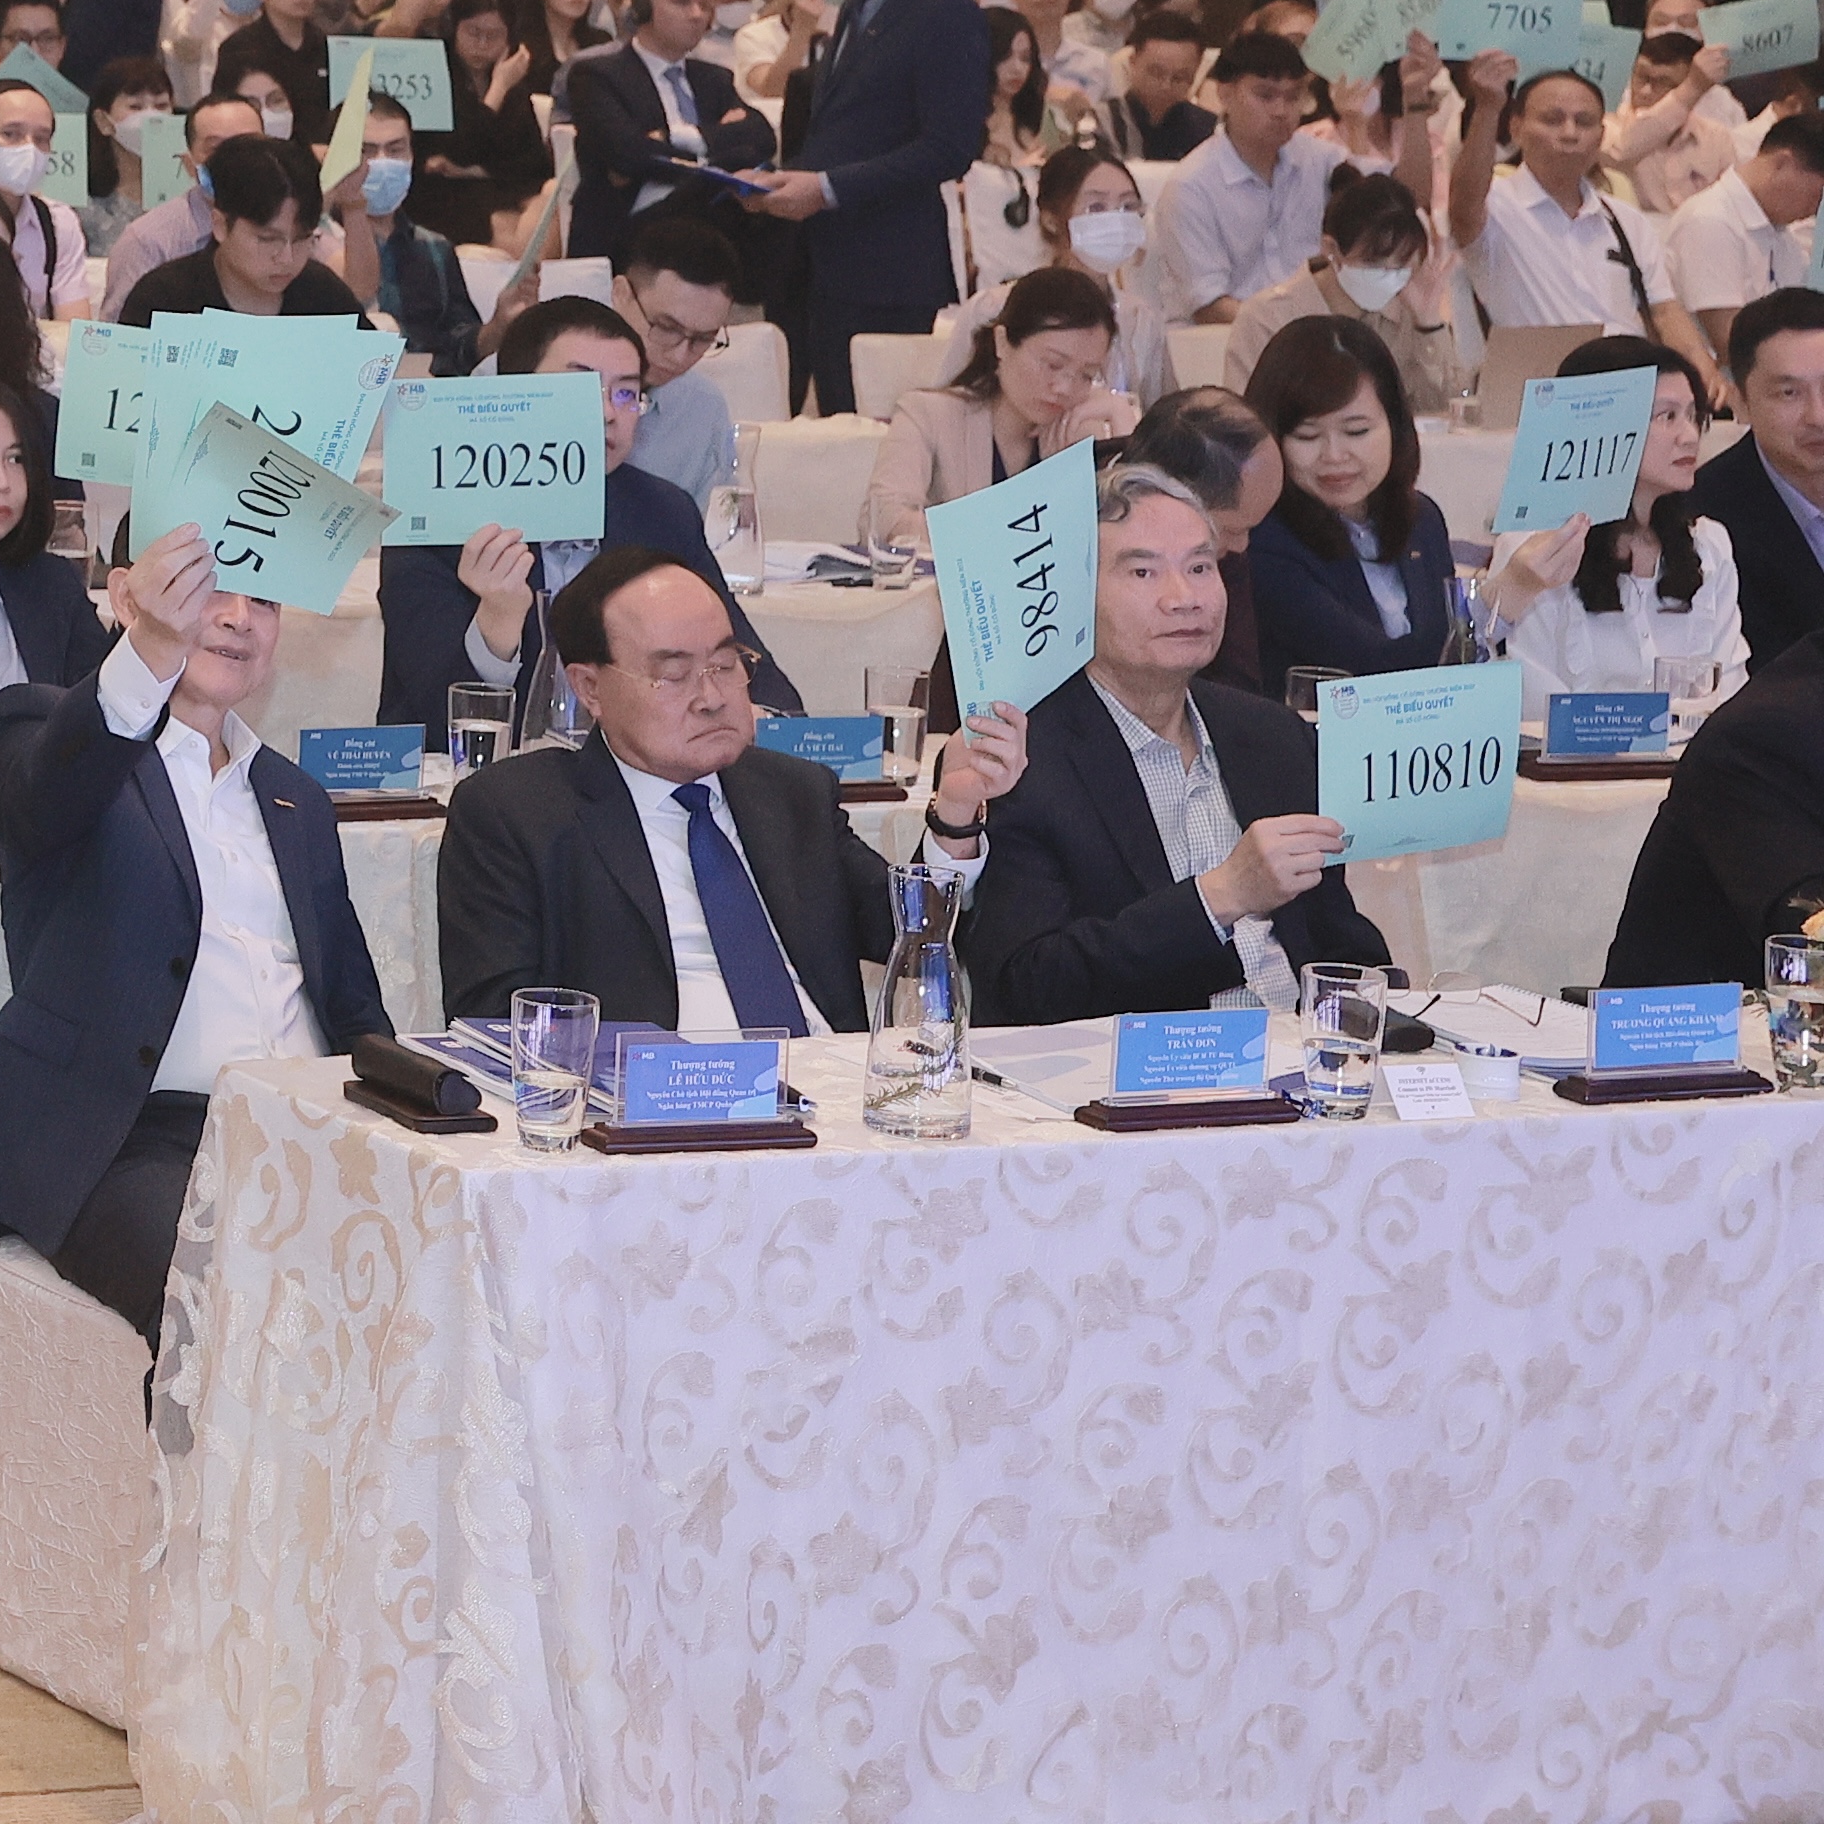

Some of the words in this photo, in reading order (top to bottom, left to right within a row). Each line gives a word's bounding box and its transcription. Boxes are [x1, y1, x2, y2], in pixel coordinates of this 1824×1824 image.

[1488, 3, 1552, 33] 7705
[1743, 23, 1793, 56] 8607
[366, 71, 434, 101] 3253
[376, 367, 388, 385] MB
[430, 440, 586, 490] 120250
[1541, 432, 1637, 481] 121117
[1008, 504, 1059, 656] 98414
[1364, 737, 1501, 802] 110810
[668, 1074, 682, 1086] LÊ
[708, 1059, 735, 1070] tướng
